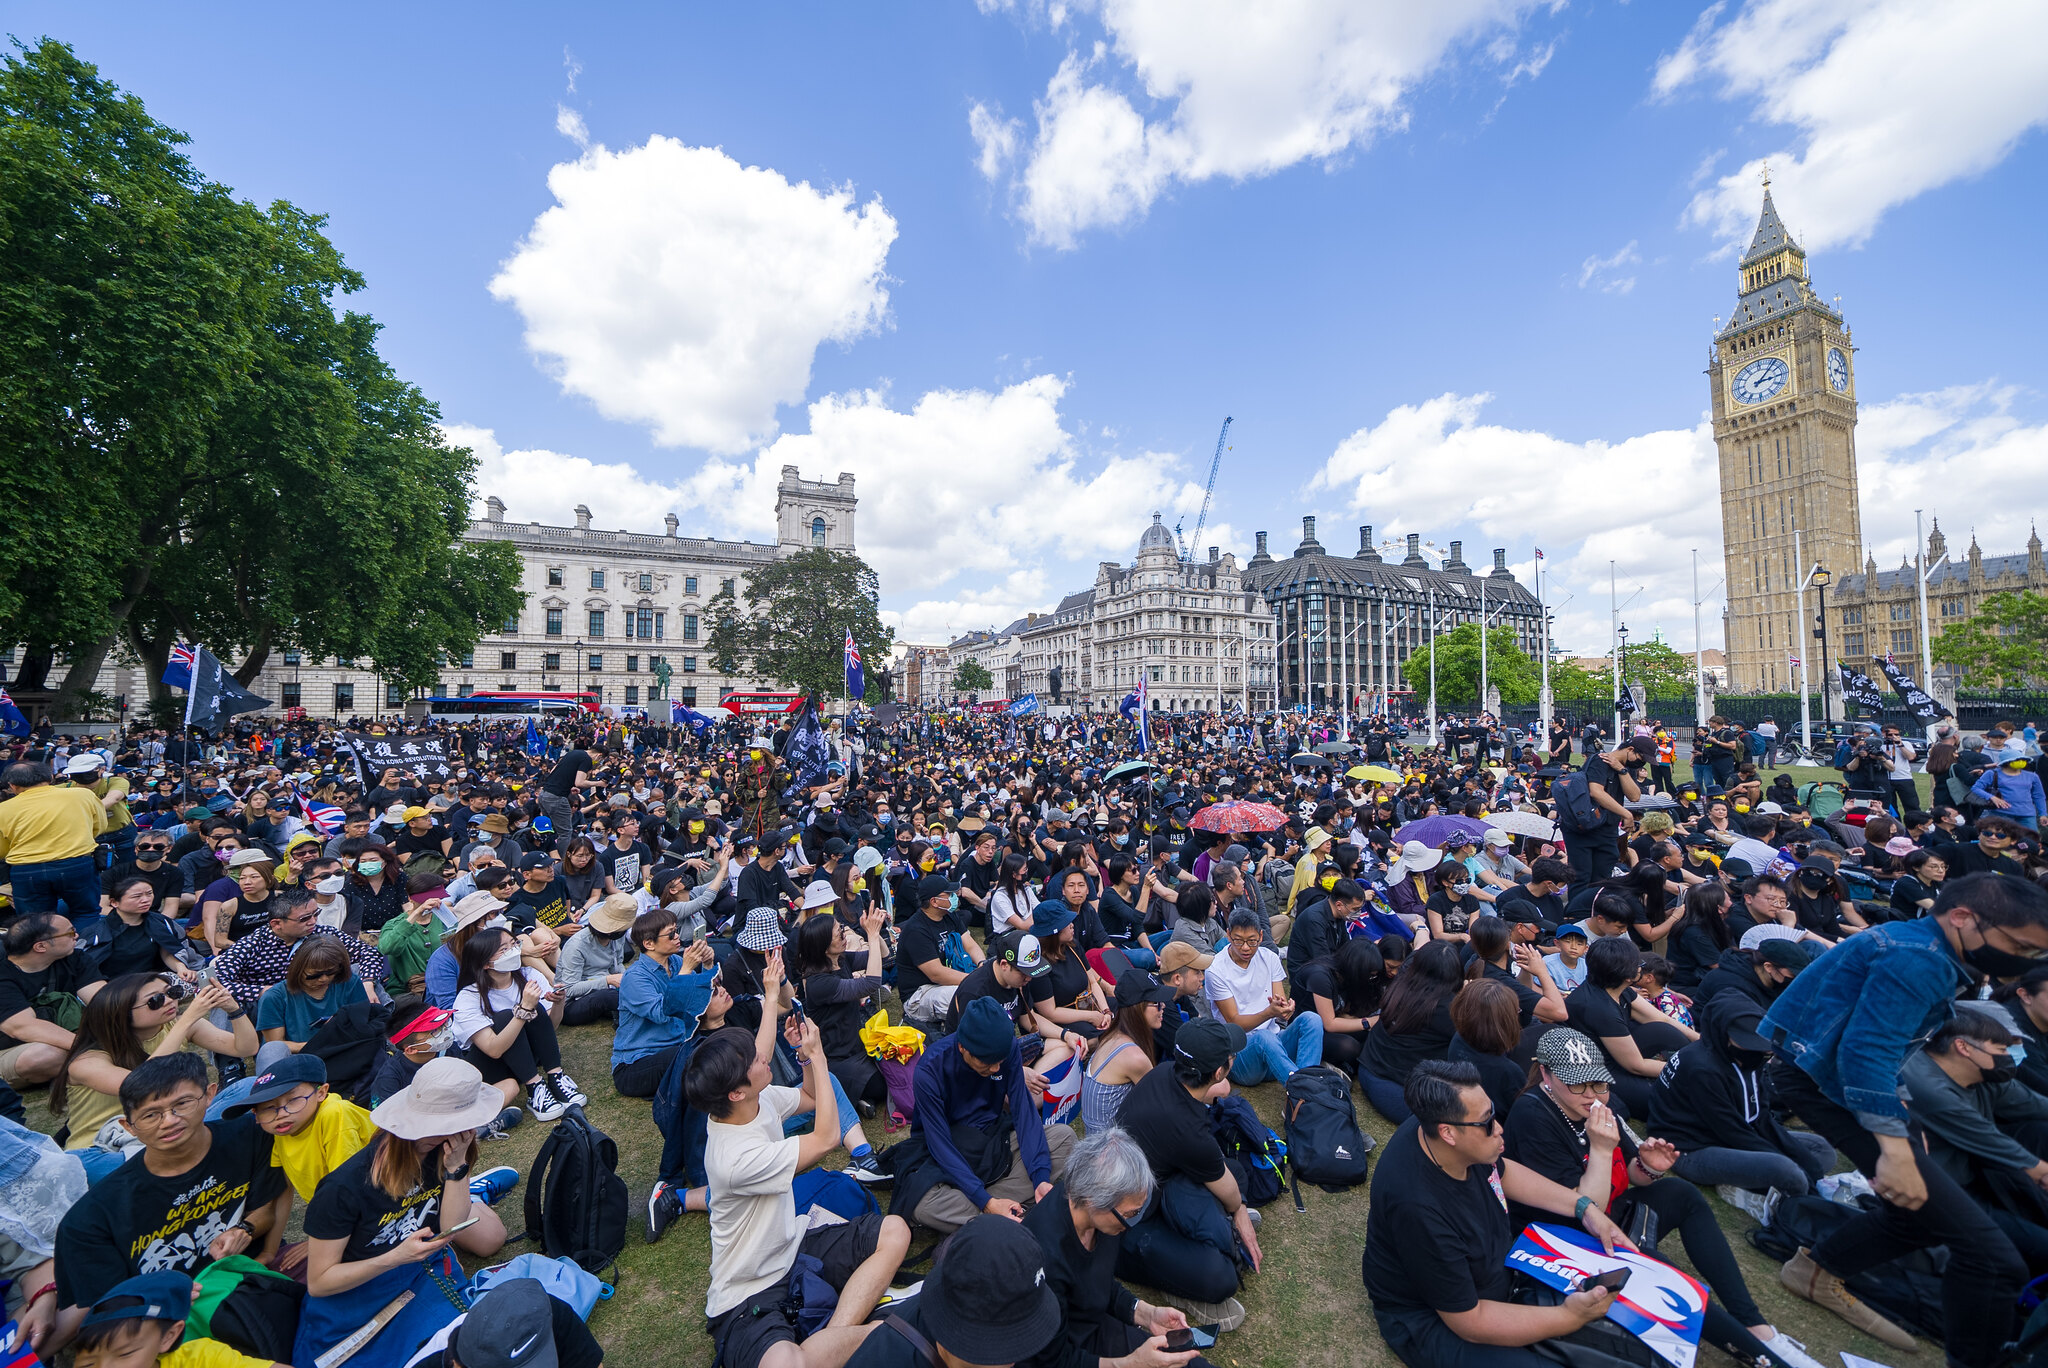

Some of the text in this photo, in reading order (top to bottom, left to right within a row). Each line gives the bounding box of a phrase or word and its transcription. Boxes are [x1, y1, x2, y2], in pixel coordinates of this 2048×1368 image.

[536, 904, 551, 917] IGHT
[538, 903, 563, 922] REEDOM
[167, 1181, 227, 1220] WE ARE
[130, 1181, 250, 1259] HONGKONGER
[1509, 1249, 1589, 1286] freed
